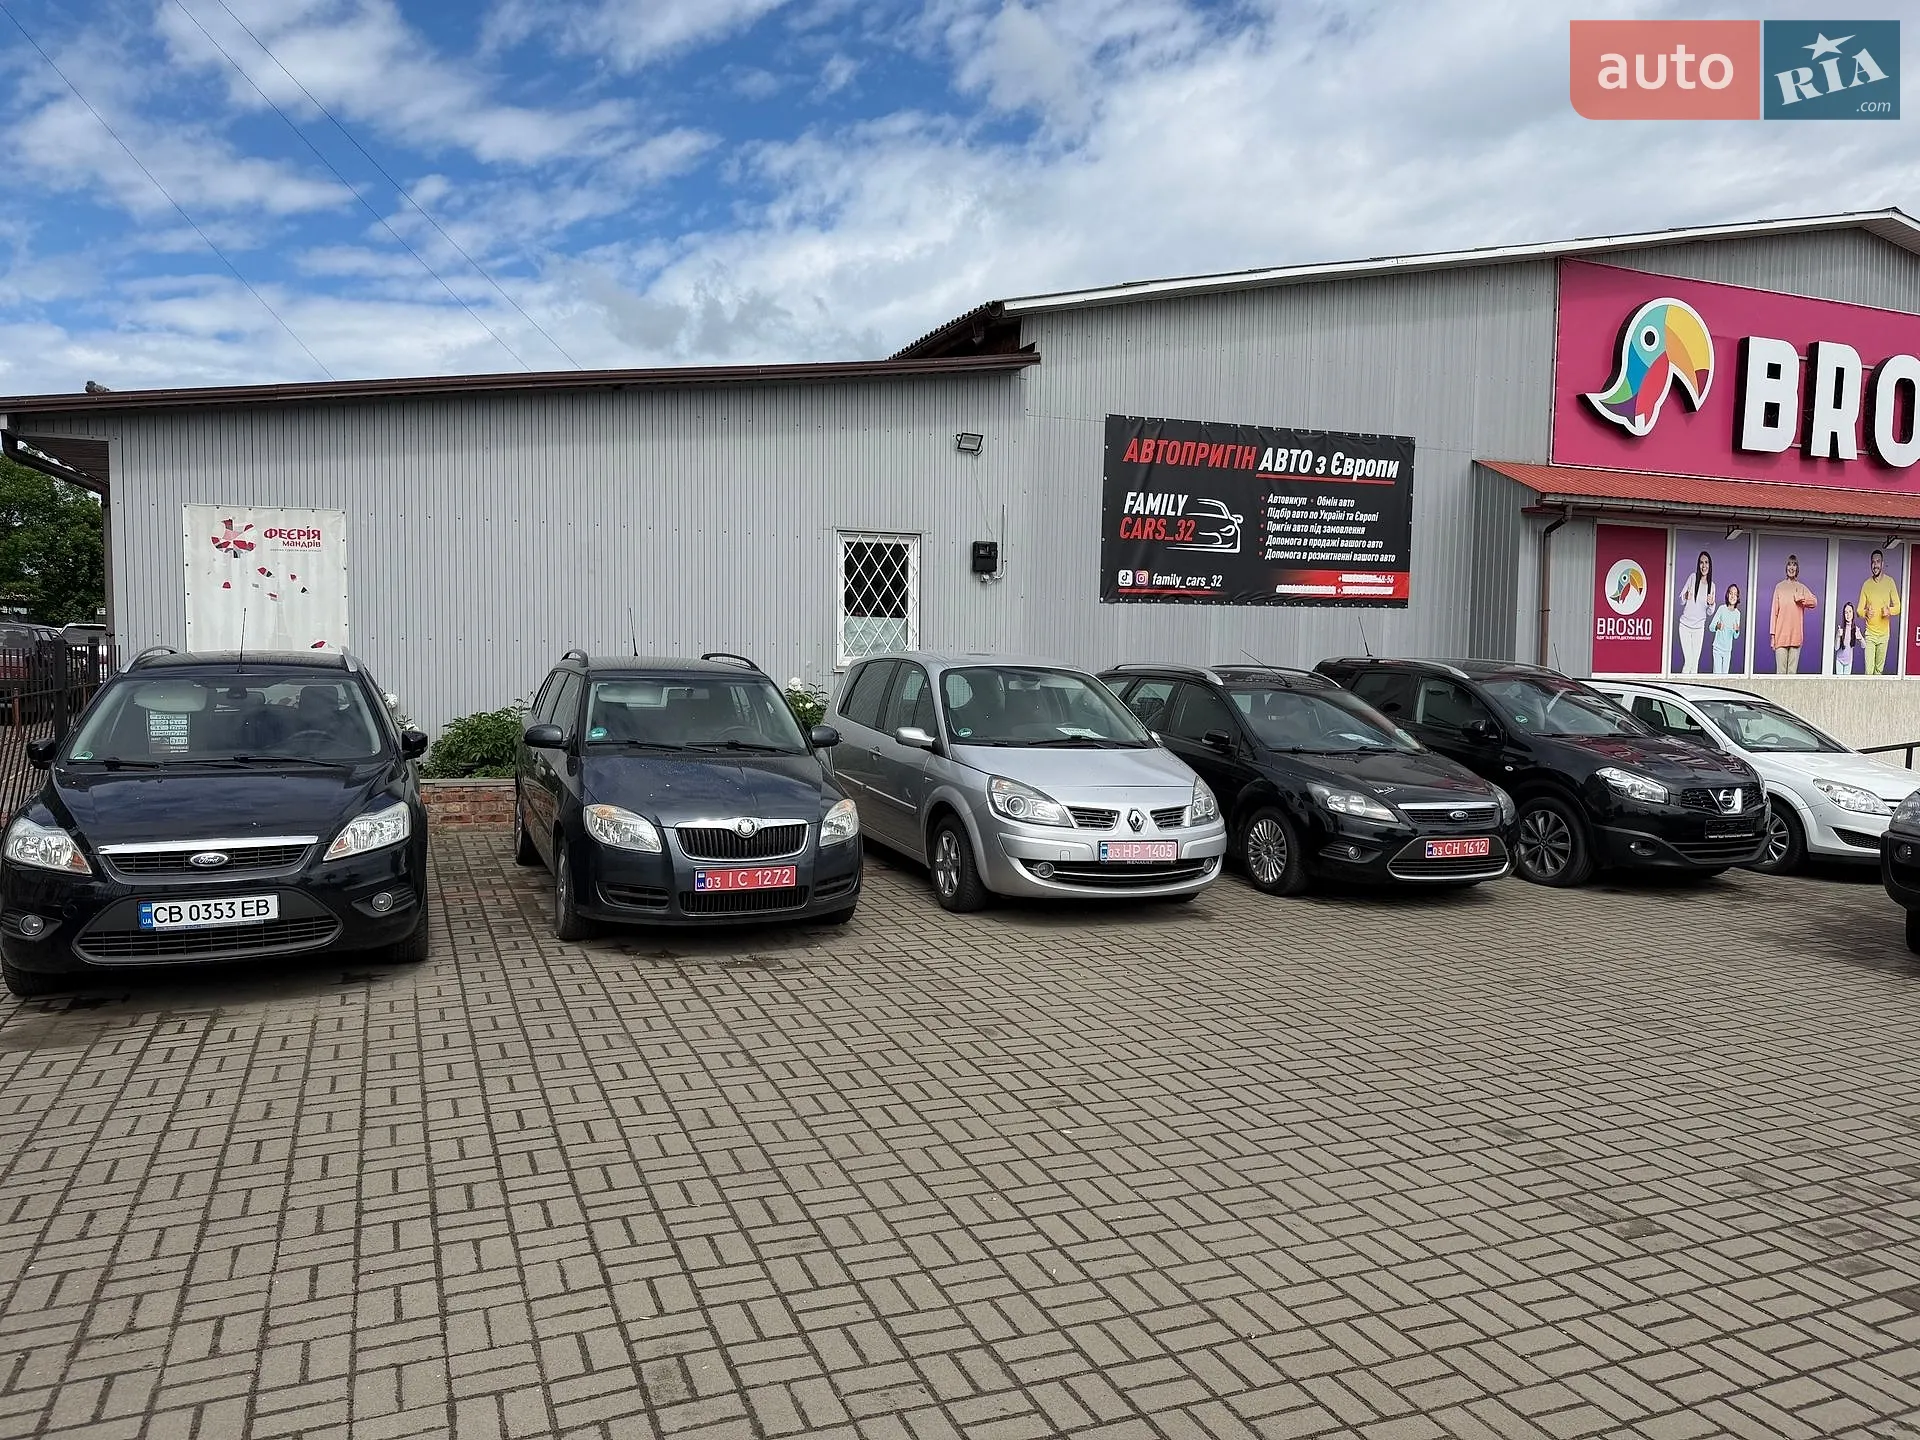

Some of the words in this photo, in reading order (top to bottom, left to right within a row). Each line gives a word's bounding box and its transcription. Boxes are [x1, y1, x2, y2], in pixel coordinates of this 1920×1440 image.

[1122, 438, 1257, 470] АВТОПРИГІН
[1258, 447, 1312, 473] АВТО
[1315, 456, 1326, 474] з
[1330, 452, 1400, 481] Європи
[1123, 491, 1189, 516] FAMILY
[1267, 493, 1308, 507] Автовикуп
[1316, 495, 1339, 507] Обмін
[1338, 498, 1355, 508] авто
[1267, 507, 1292, 520] Підбір
[1291, 510, 1309, 519] авто
[1308, 511, 1319, 520] по
[1319, 509, 1346, 522] Україні
[1345, 512, 1354, 521] та
[1354, 511, 1380, 524] Європі
[263, 526, 321, 541] ФЕЄРІЯ
[1120, 516, 1196, 542] CARS_32
[1266, 521, 1292, 533] Пригін
[1292, 524, 1309, 533] авто
[1309, 523, 1322, 535] під
[1322, 525, 1366, 535] замовлення
[282, 540, 321, 549] мандрів
[1265, 534, 1302, 547] Допомога
[1302, 538, 1309, 547] в
[1308, 537, 1340, 549] продажі
[1340, 539, 1367, 548] вашого
[1366, 540, 1384, 549] авто
[1264, 548, 1302, 561] Допомога
[1302, 552, 1308, 560] в
[1307, 551, 1353, 562] розмитненні
[1353, 553, 1380, 562] вашого
[1379, 554, 1396, 563] авто
[1152, 572, 1223, 589] family_cars_32
[1596, 617, 1653, 637] BROSKO
[1123, 844, 1141, 858] HP
[1145, 844, 1174, 858] 1405
[1432, 847, 1443, 856] 03
[1444, 843, 1461, 855] CH
[1463, 840, 1487, 854] 1612
[706, 877, 721, 888] 03
[728, 871, 748, 888] IC
[755, 869, 791, 886] 1272
[153, 905, 184, 924] CB
[188, 901, 236, 921] 0353
[241, 898, 270, 918] EB
